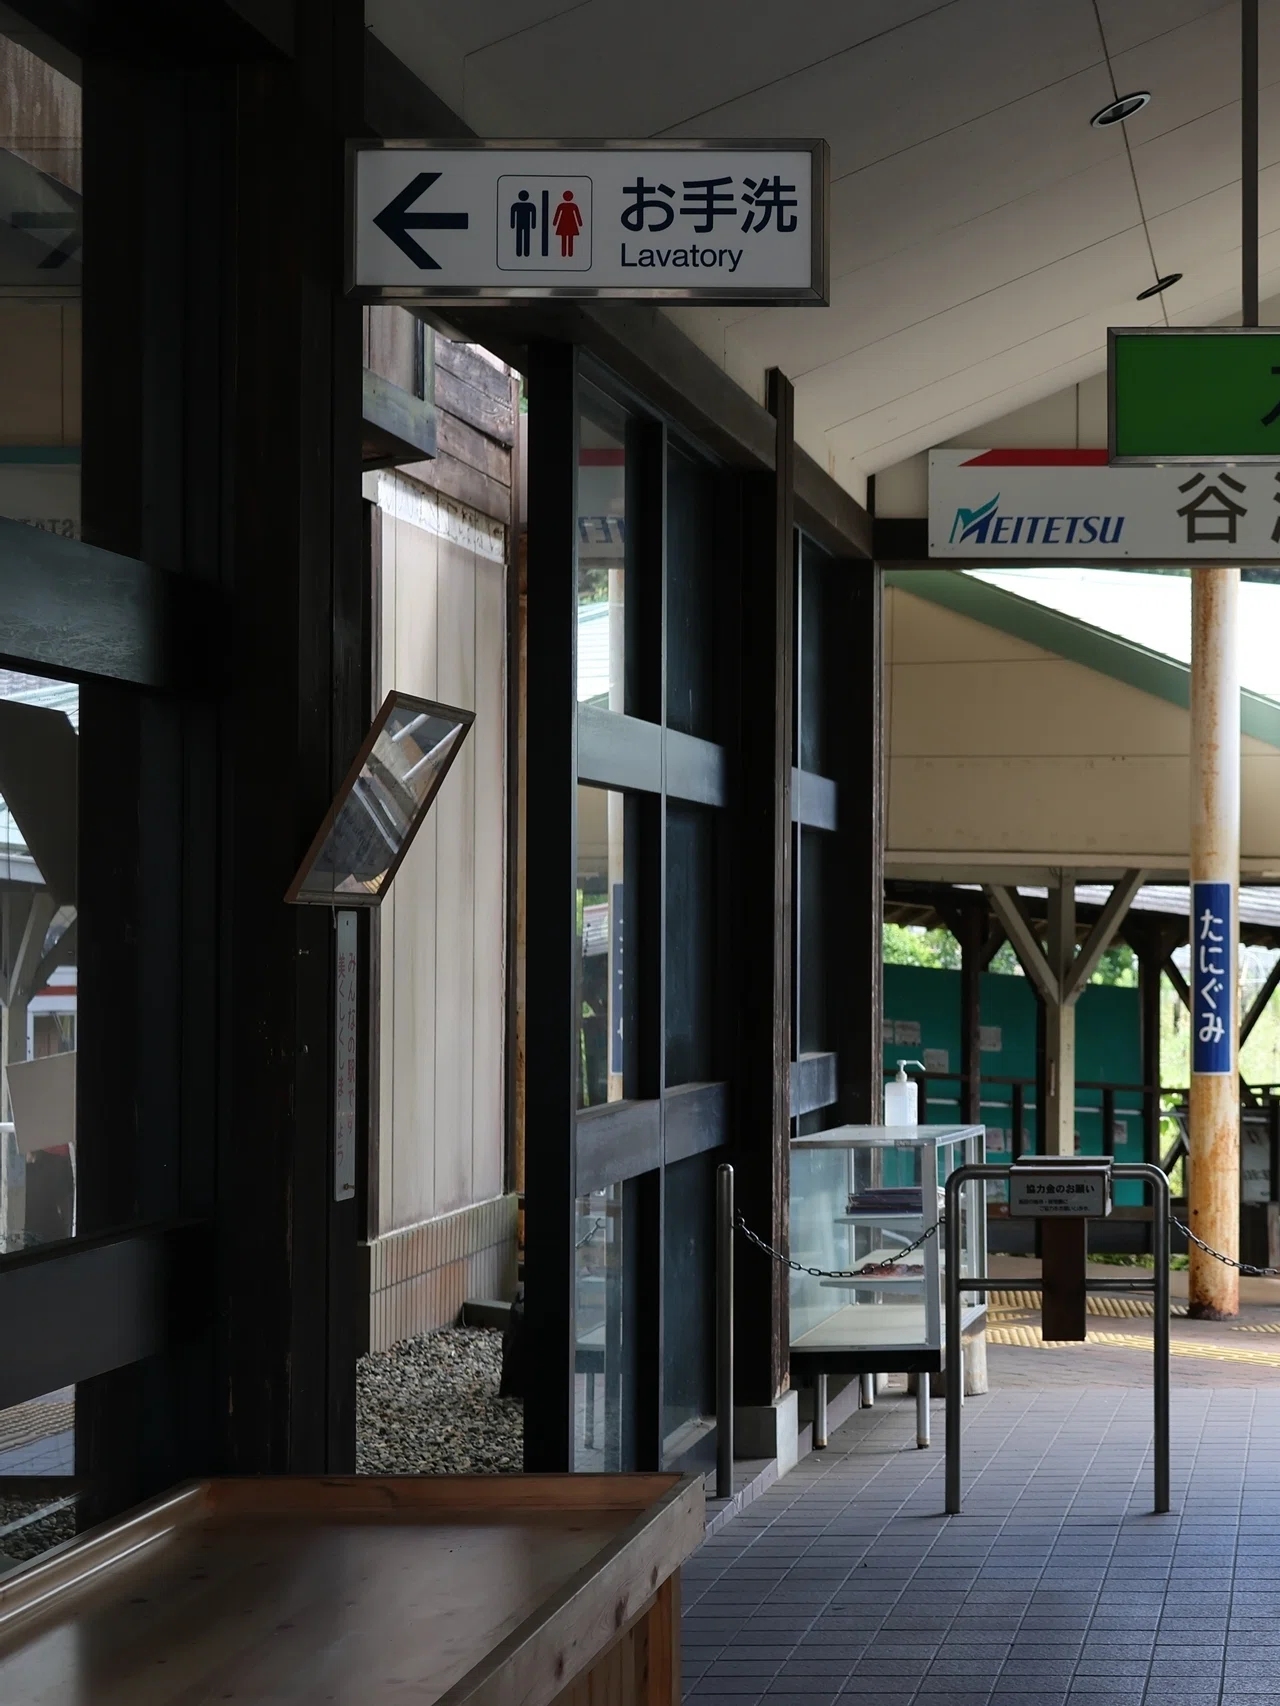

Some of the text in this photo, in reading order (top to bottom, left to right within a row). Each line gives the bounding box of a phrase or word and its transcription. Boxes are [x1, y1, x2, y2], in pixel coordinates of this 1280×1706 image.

[620, 176, 798, 234] お手洗
[620, 242, 743, 272] Lavatory
[949, 492, 1126, 545] MEITETSU
[1199, 907, 1226, 1044] たにぐみ
[1026, 1183, 1095, 1194] 協力金のお願い
